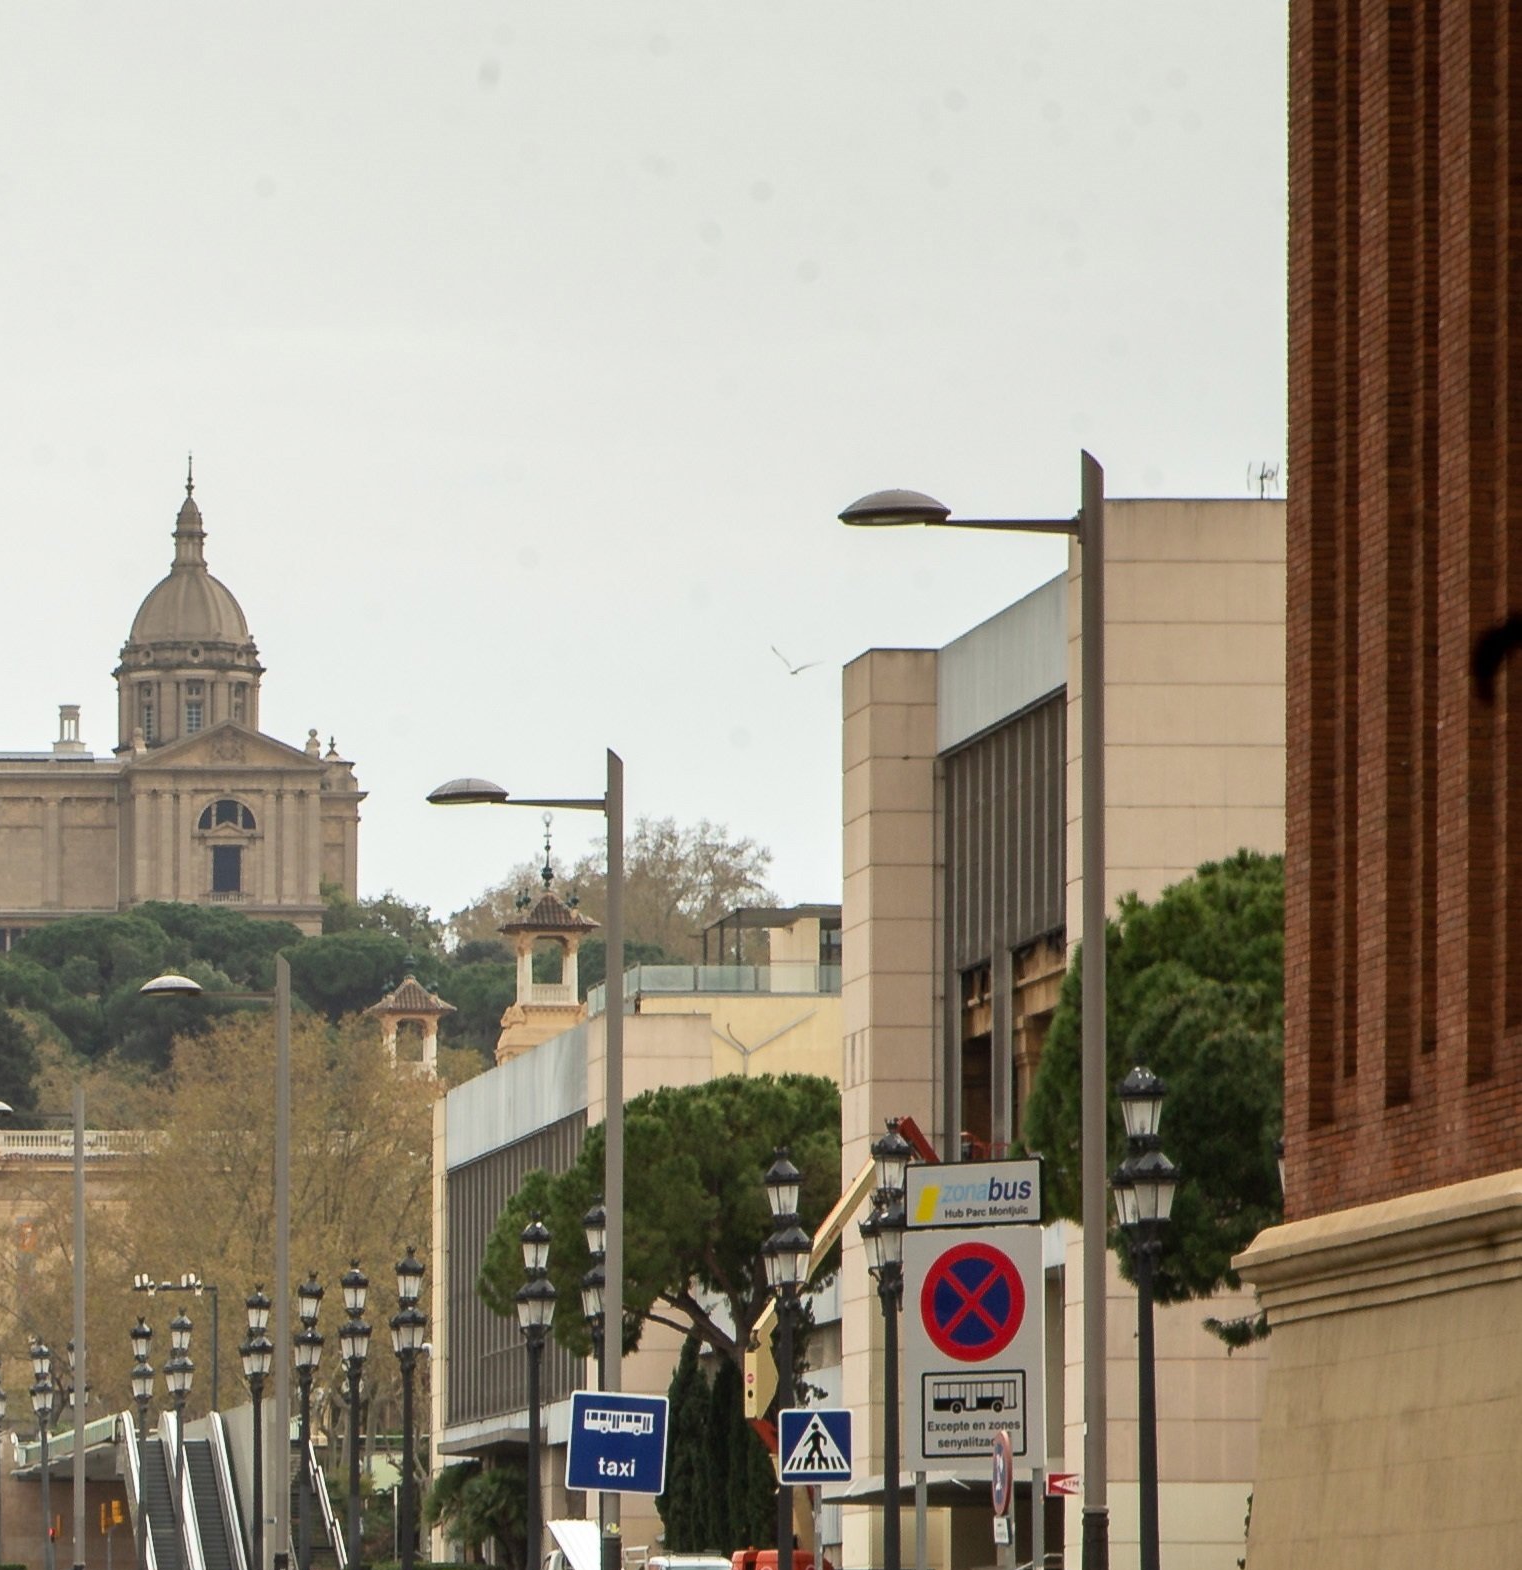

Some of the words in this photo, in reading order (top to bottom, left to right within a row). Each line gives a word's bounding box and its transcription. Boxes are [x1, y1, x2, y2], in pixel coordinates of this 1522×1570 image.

[944, 1209, 964, 1219] Hub
[966, 1208, 986, 1218] Parc
[927, 1420, 970, 1434] Excepte
[972, 1421, 986, 1431] en
[988, 1420, 1021, 1431] zones
[937, 1432, 1011, 1450] senyalitza
[598, 1457, 636, 1477] taxi
